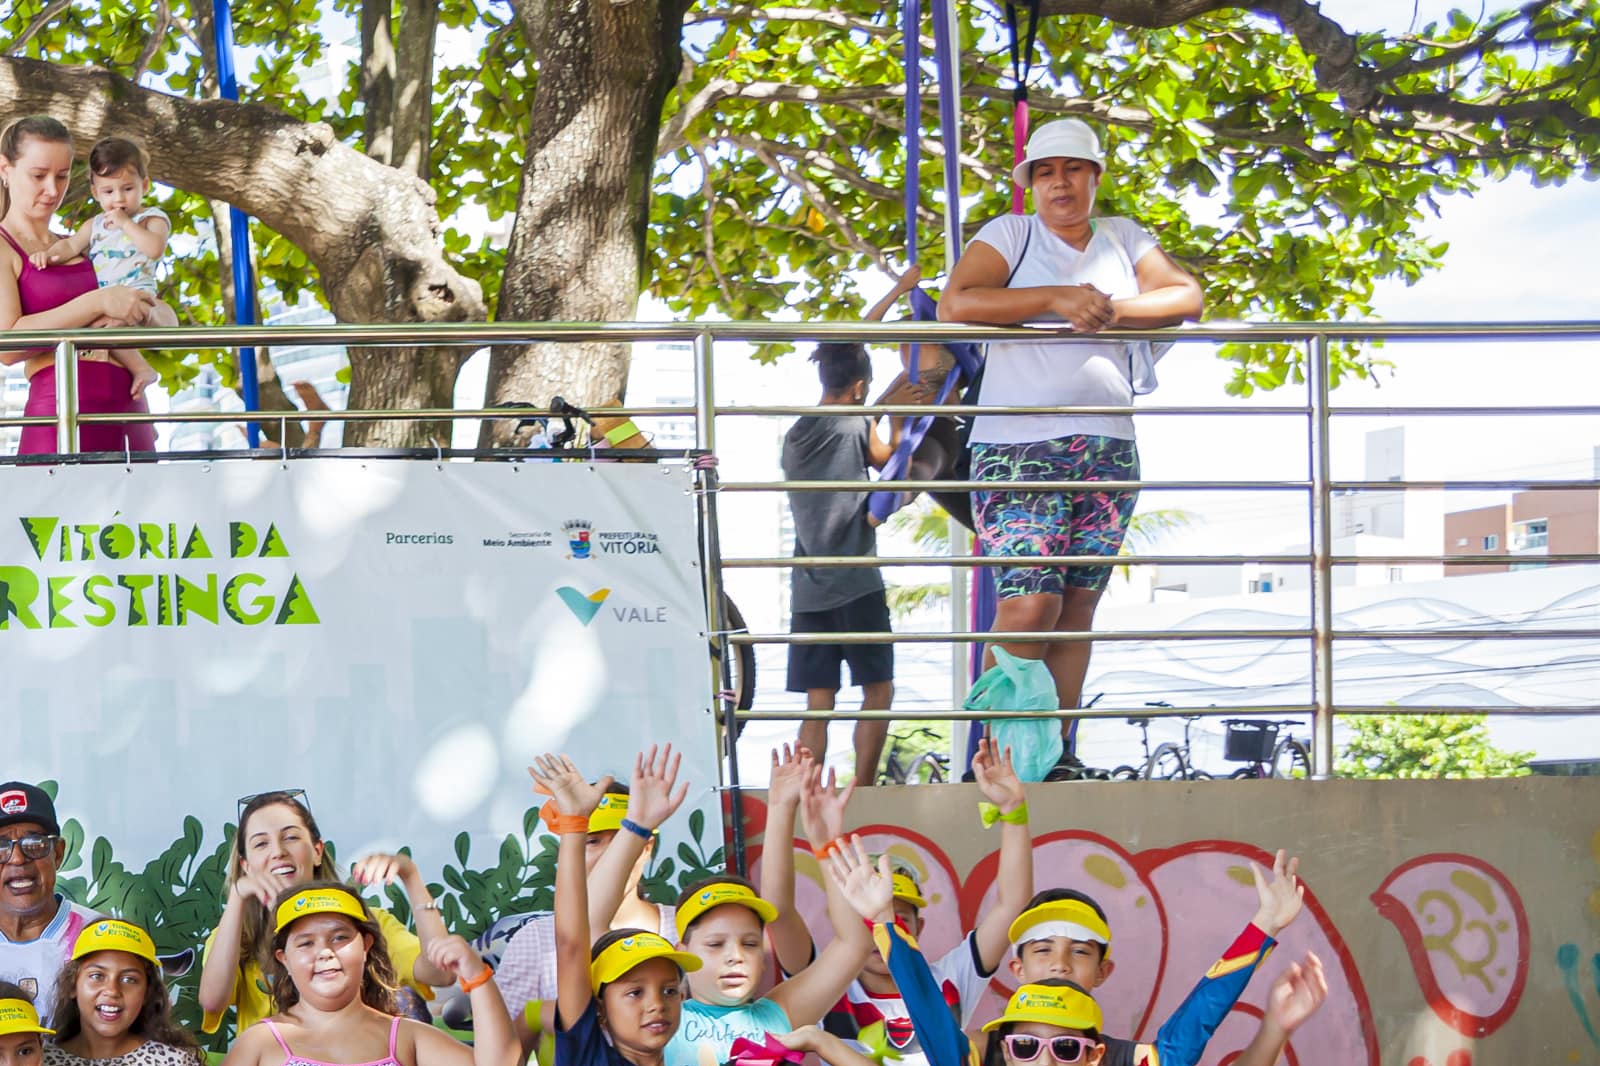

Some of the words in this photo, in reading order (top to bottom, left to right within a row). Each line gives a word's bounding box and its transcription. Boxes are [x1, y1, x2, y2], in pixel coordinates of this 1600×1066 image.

[19, 510, 213, 562] VITÓRIA
[229, 521, 290, 559] DA
[386, 532, 454, 545] Parcerias
[600, 532, 649, 541] PREFEITURA
[483, 539, 505, 547] Meio
[507, 539, 552, 547] Ambiente
[600, 540, 661, 554] VITÓRIA
[613, 607, 667, 623] VALE
